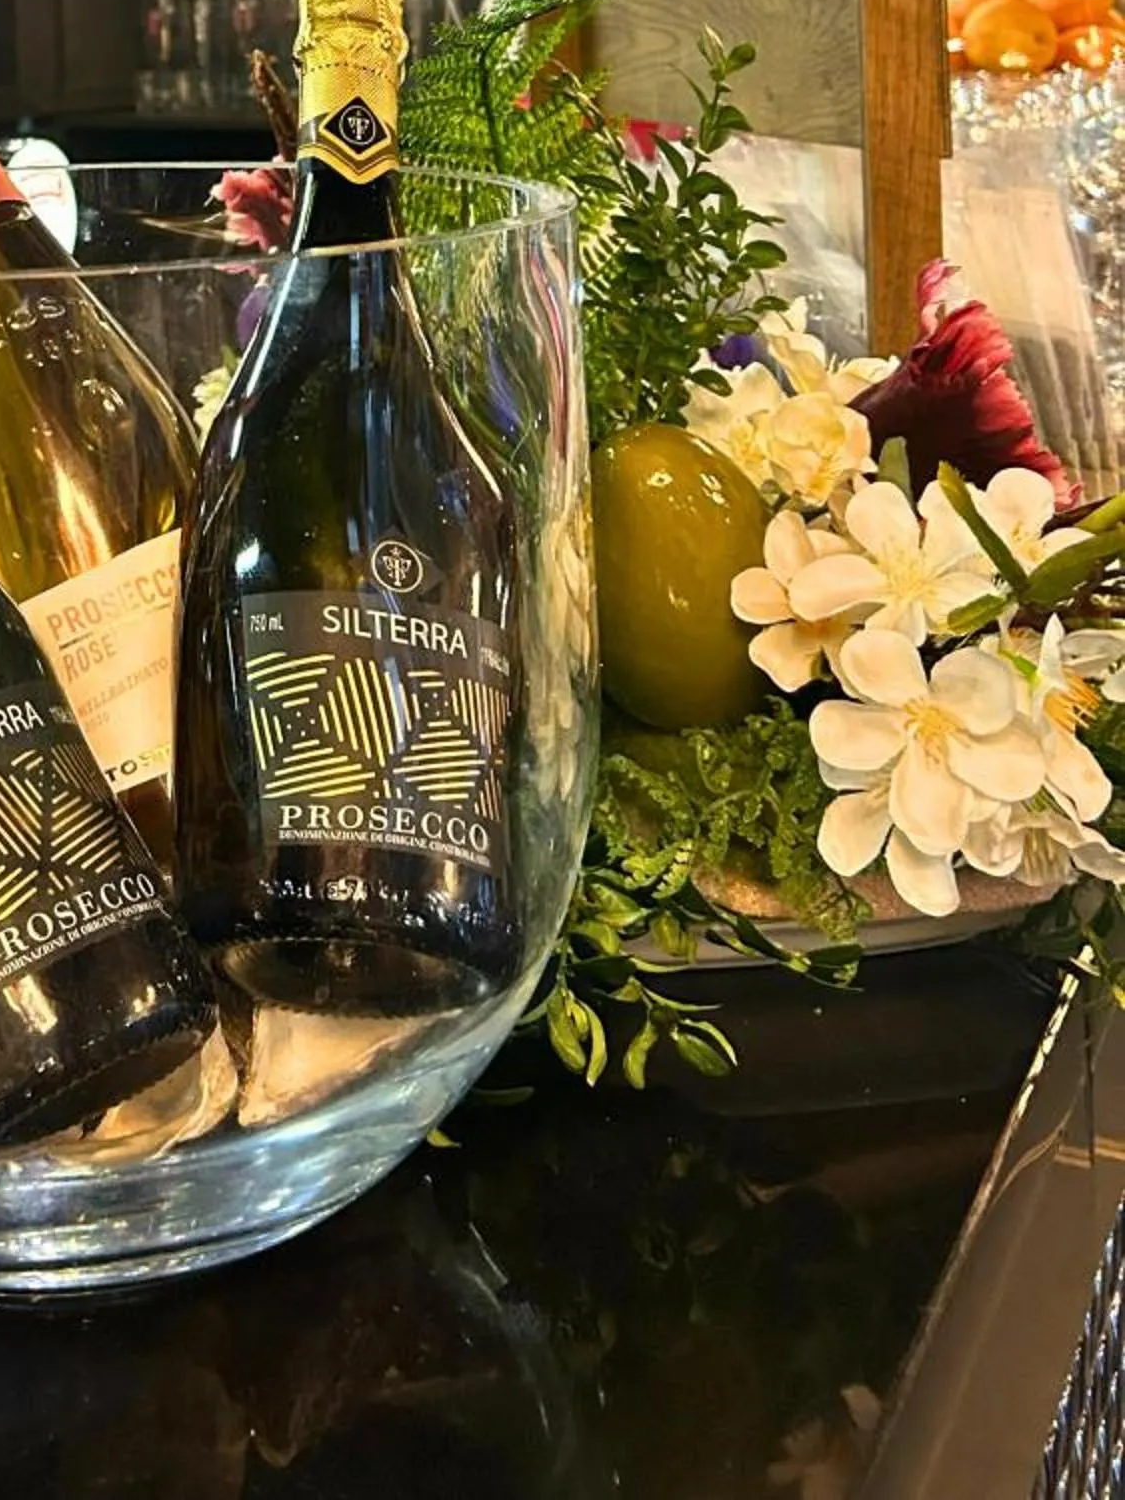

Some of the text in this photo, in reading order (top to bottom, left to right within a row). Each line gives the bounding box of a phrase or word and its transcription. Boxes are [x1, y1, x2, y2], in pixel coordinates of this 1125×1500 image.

[322, 605, 468, 659] SILTERRA
[278, 803, 489, 852] PROSECCO
[278, 829, 369, 842] DENOMINAZIONE
[384, 834, 427, 850] ORIGINE
[80, 912, 116, 936] ORIGINE
